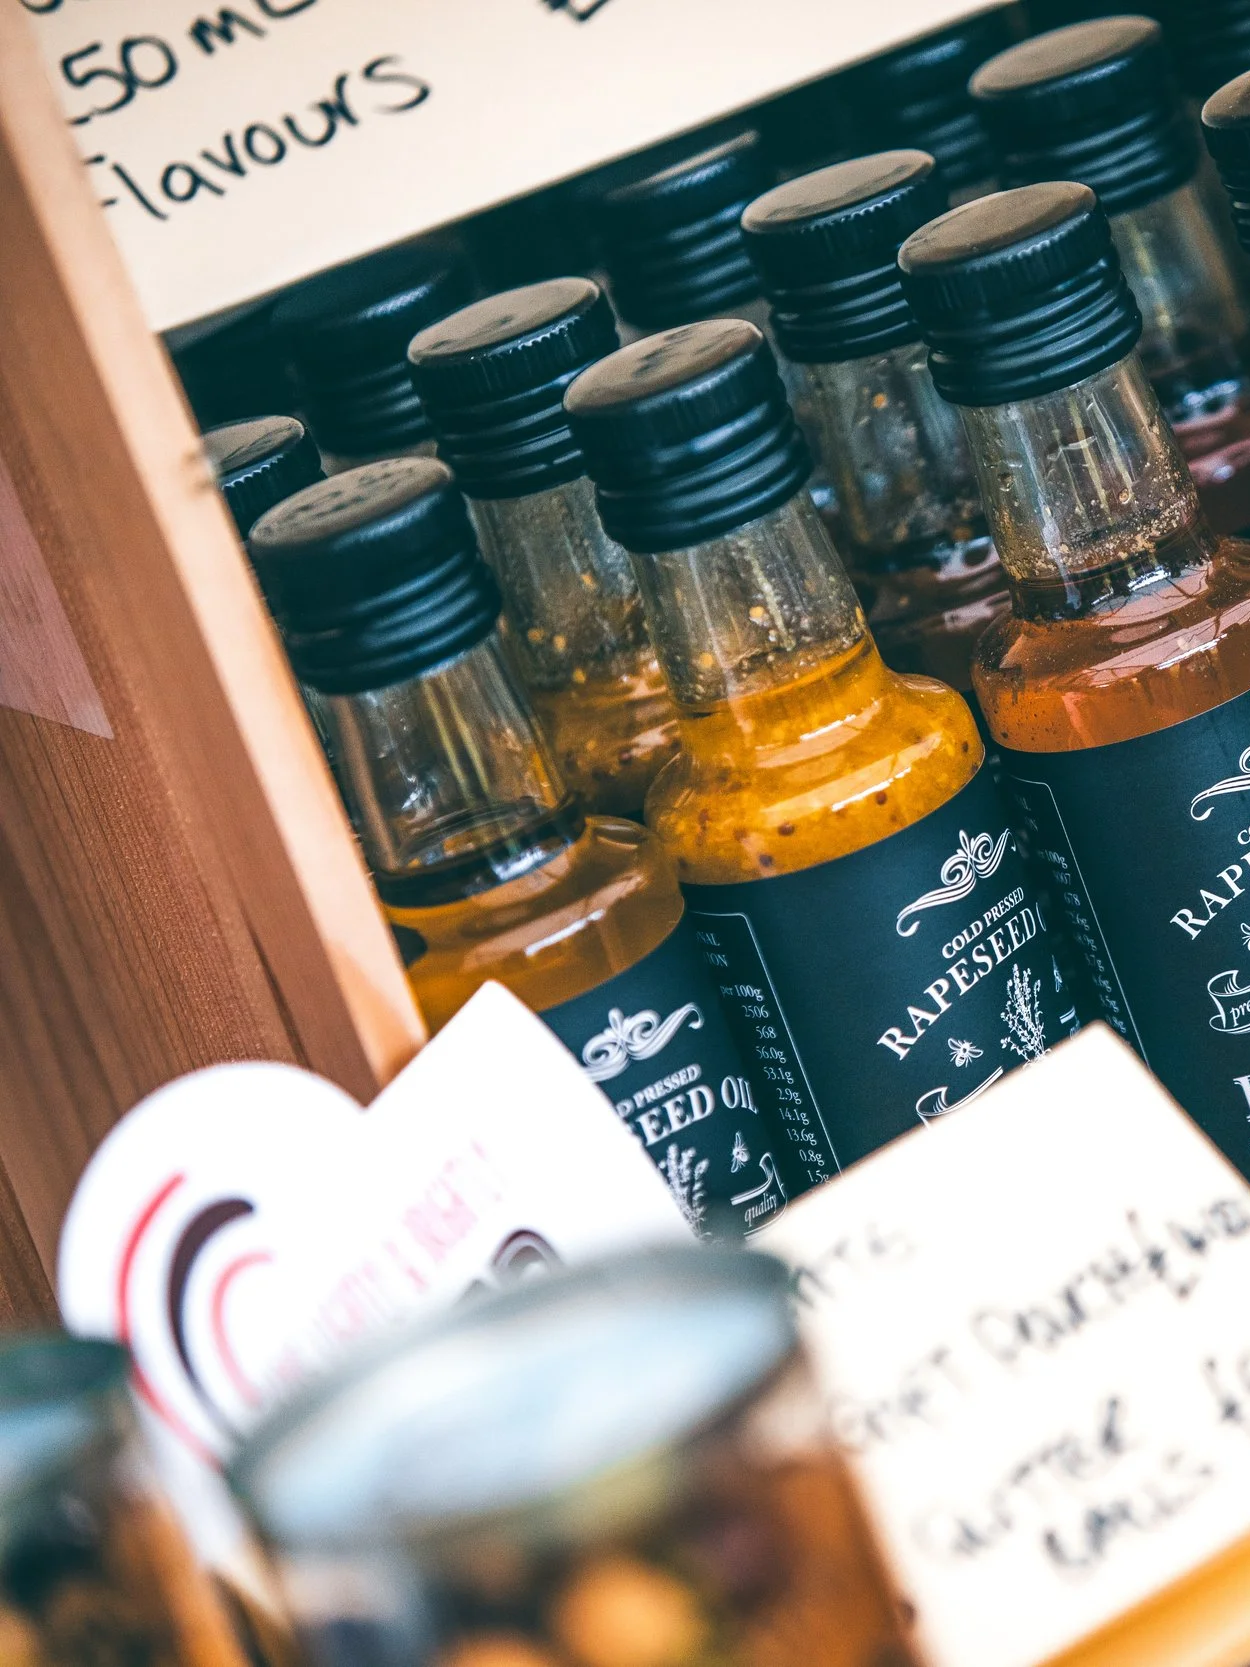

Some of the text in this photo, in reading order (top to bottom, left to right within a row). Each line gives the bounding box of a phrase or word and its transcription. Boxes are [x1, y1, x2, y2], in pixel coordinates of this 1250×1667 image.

[61, 35, 179, 125] 50
[942, 920, 982, 959] COLD
[983, 886, 1024, 927] PRESSED
[734, 985, 764, 1001] 100g
[877, 907, 1036, 1061] RAPESEED
[741, 1005, 769, 1018] 2506
[756, 1025, 776, 1039] 568
[756, 1046, 786, 1064] 56.0g
[763, 1067, 794, 1084] 53.1g
[632, 1063, 702, 1108] PRESSED
[721, 1075, 758, 1114] OIL
[776, 1087, 802, 1104] 2.9g
[778, 1108, 810, 1125] 14.1g
[786, 1128, 817, 1146] 13.6g
[799, 1149, 824, 1166] 0.8g
[744, 1193, 778, 1228] quality
